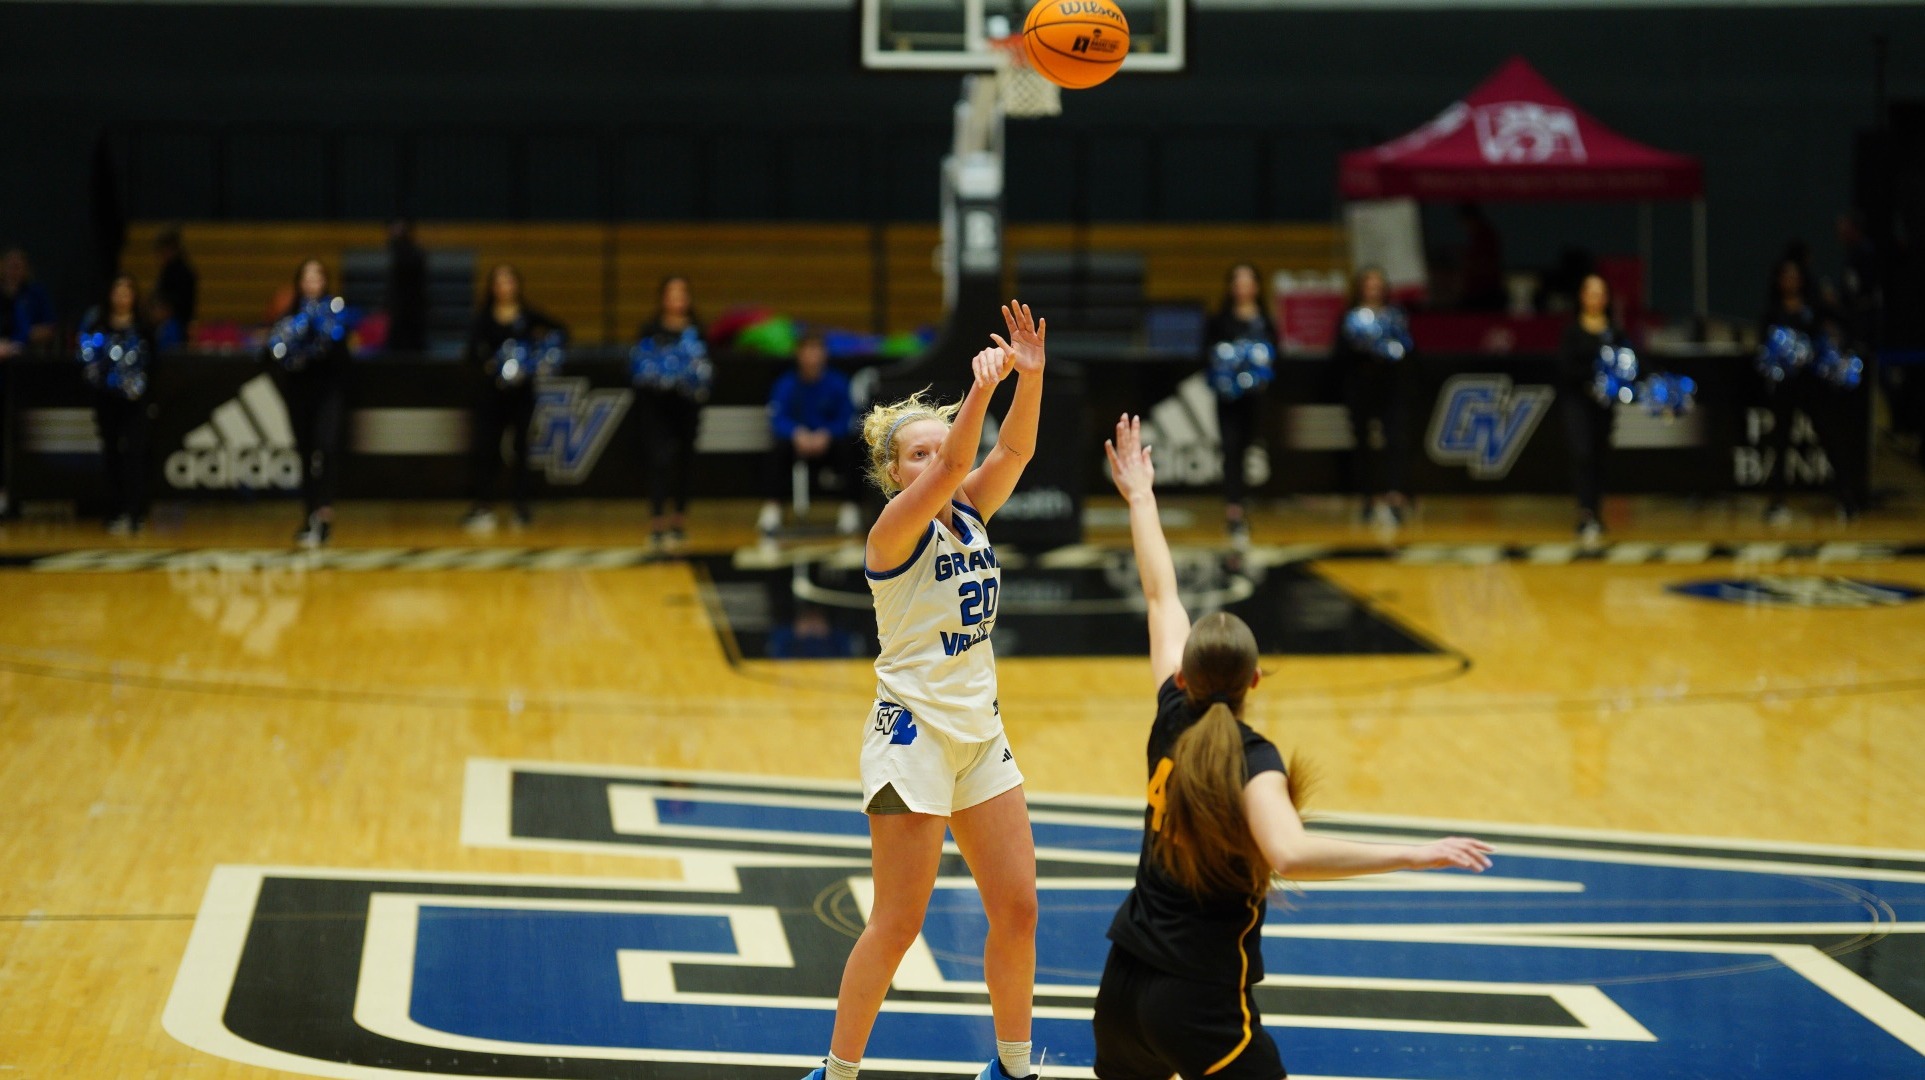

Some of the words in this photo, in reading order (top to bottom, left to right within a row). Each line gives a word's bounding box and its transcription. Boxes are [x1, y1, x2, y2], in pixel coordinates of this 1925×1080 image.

[1059, 0, 1123, 24] Wilson
[164, 449, 304, 491] adida
[935, 546, 1001, 582] GRAN
[958, 577, 998, 626] 20
[1147, 757, 1174, 832] 4
